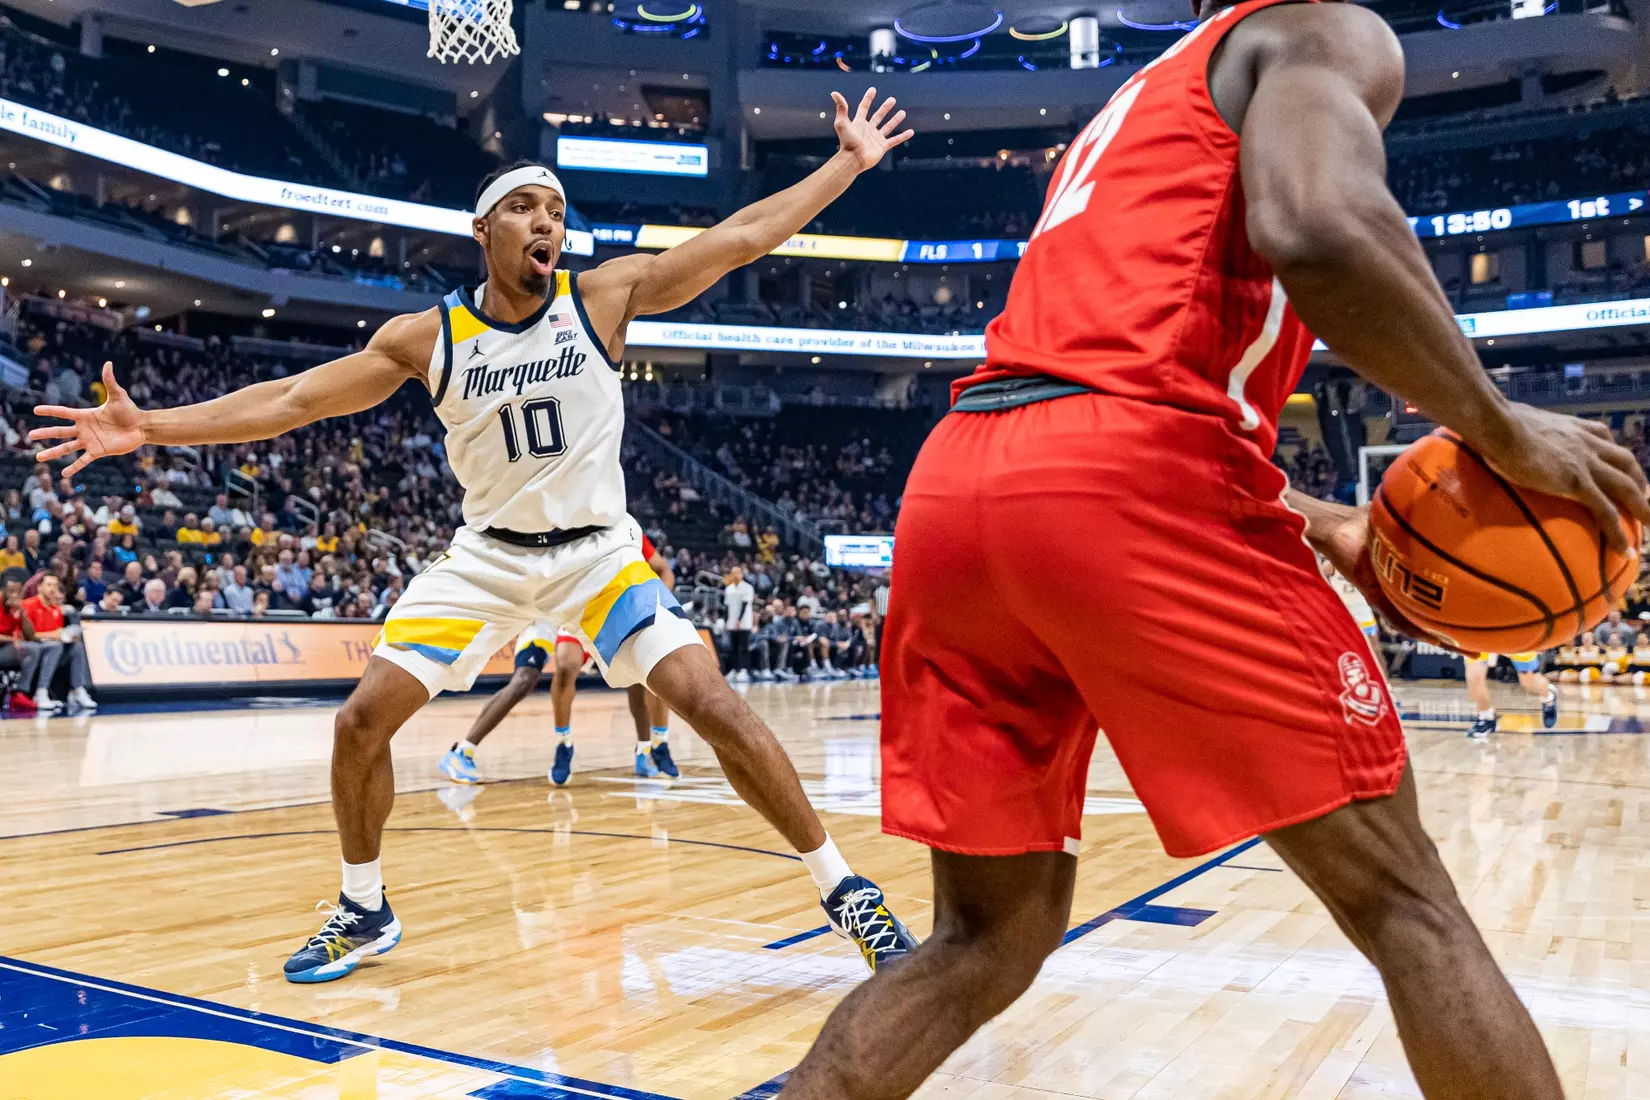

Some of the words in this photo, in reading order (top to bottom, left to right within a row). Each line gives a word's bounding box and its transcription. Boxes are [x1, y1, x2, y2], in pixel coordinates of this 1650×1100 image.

[22, 112, 77, 143] family
[1431, 208, 1513, 236] 13:50
[1567, 196, 1611, 219] 1st
[920, 244, 948, 260] FLS
[972, 242, 983, 259] 1
[662, 329, 712, 341] Official
[718, 331, 761, 344] health
[766, 335, 794, 345] care
[798, 335, 855, 348] provider
[860, 339, 872, 348] of
[876, 339, 897, 349] the
[903, 340, 976, 352] Milwaukee
[461, 345, 587, 400] Marquette
[498, 396, 568, 463] 10
[105, 629, 279, 677] Continental
